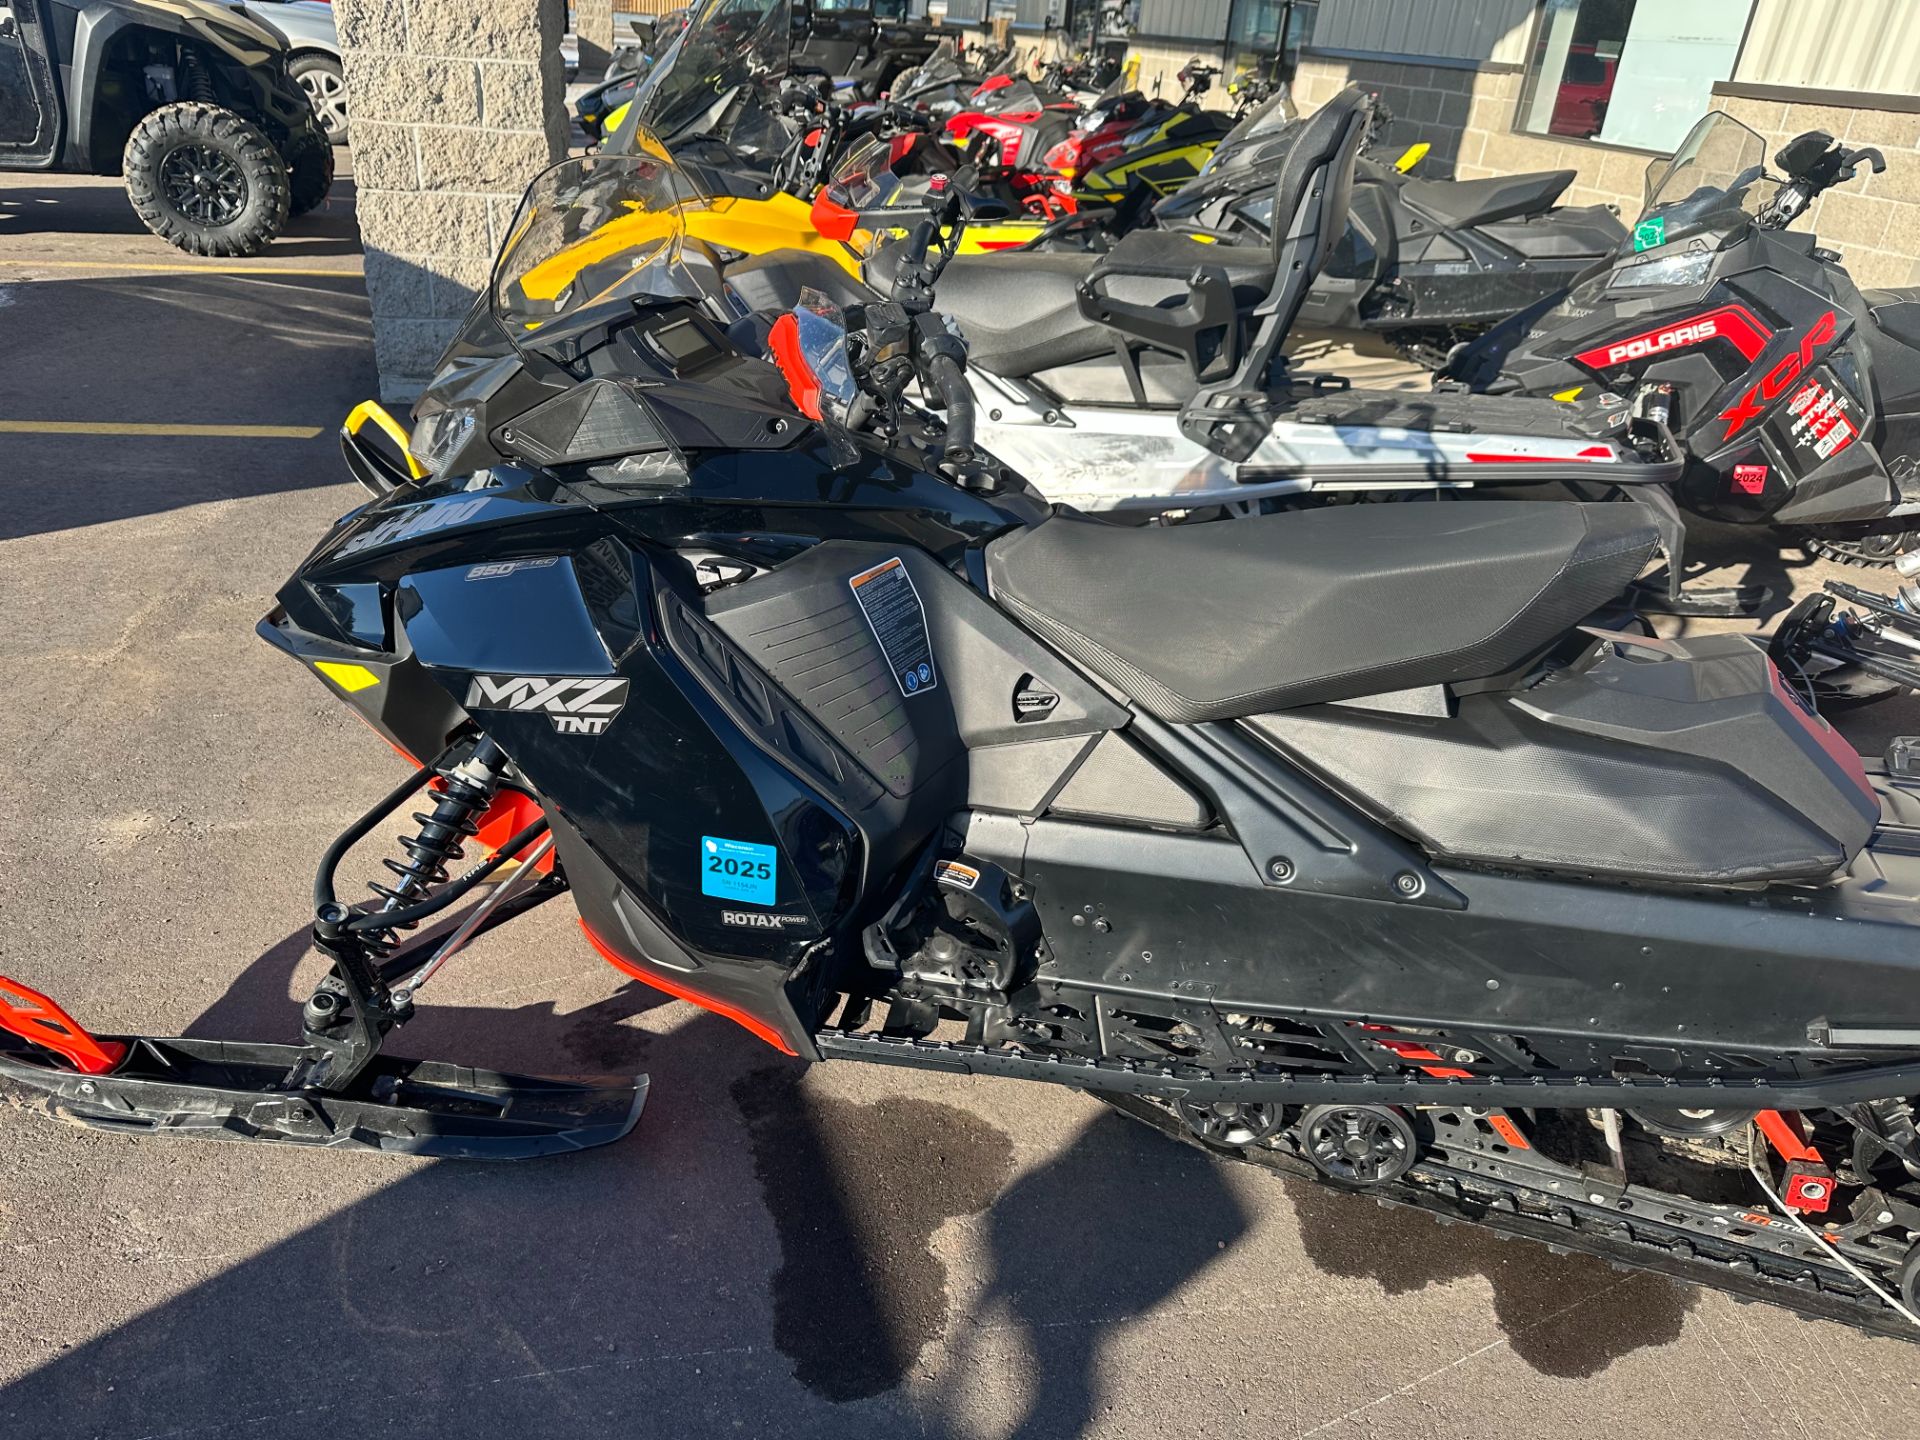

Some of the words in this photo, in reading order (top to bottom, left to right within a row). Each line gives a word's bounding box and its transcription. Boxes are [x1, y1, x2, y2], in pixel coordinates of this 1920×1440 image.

[1608, 320, 1717, 364] POLARIS
[1718, 311, 1837, 442] XCR
[1735, 473, 1763, 483] 2024
[467, 562, 513, 579] 850
[514, 557, 554, 569] E-TEC
[466, 675, 629, 713] MXZ
[551, 715, 610, 734] TNT
[708, 855, 772, 881] 2025
[723, 911, 783, 928] ROTAX
[781, 916, 806, 924] POWER
